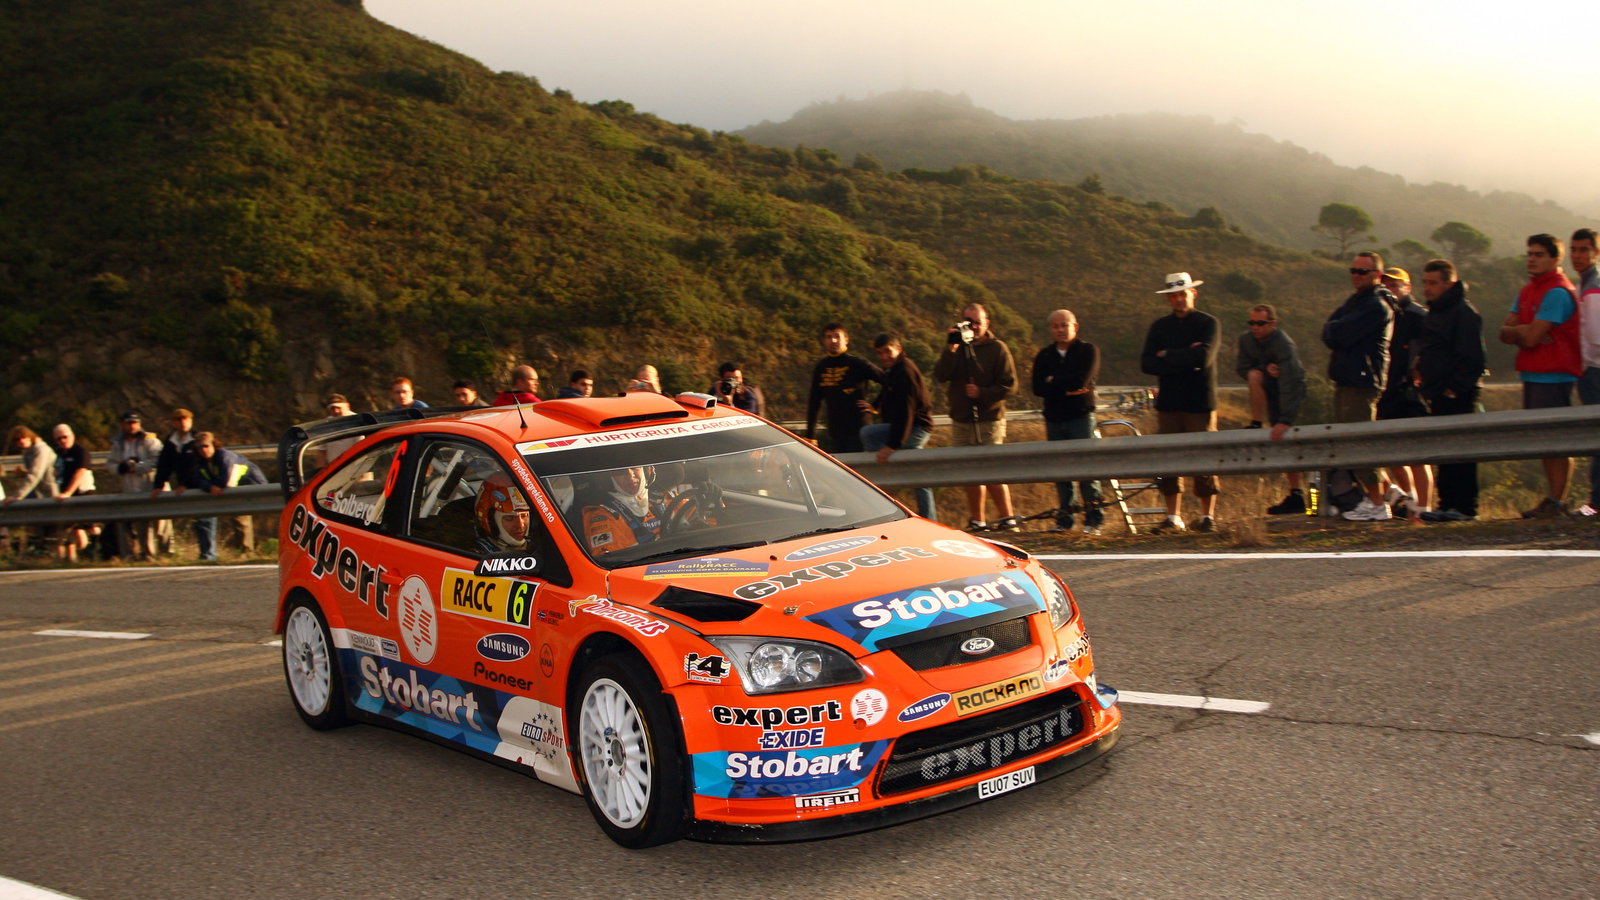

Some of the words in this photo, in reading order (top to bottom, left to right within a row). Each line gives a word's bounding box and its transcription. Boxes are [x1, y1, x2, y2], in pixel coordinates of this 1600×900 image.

[584, 426, 688, 444] HURTIGRUTA
[691, 418, 759, 431] CARGLASS
[511, 457, 555, 524] spydebergreklame.no
[333, 490, 377, 526] Solberg
[288, 503, 392, 621] expert
[792, 538, 871, 557] SAMSUNG
[480, 556, 537, 574] NIKKO
[733, 546, 938, 601] expert
[453, 577, 497, 613] RACC
[512, 582, 529, 624] 6
[851, 574, 1025, 629] Stobart
[483, 637, 525, 657] SAMSUNG
[968, 638, 988, 650] Ford
[474, 661, 534, 691] Pioneer
[359, 654, 483, 732] Stobart
[903, 698, 948, 717] SAMSUNG
[712, 699, 842, 730] expert
[758, 728, 825, 750] EXIDE
[920, 708, 1073, 781] expert
[725, 746, 864, 779] Stobart
[795, 788, 860, 808] PIRELLI
[981, 776, 1008, 797] EU07
[1012, 769, 1034, 788] SUV
